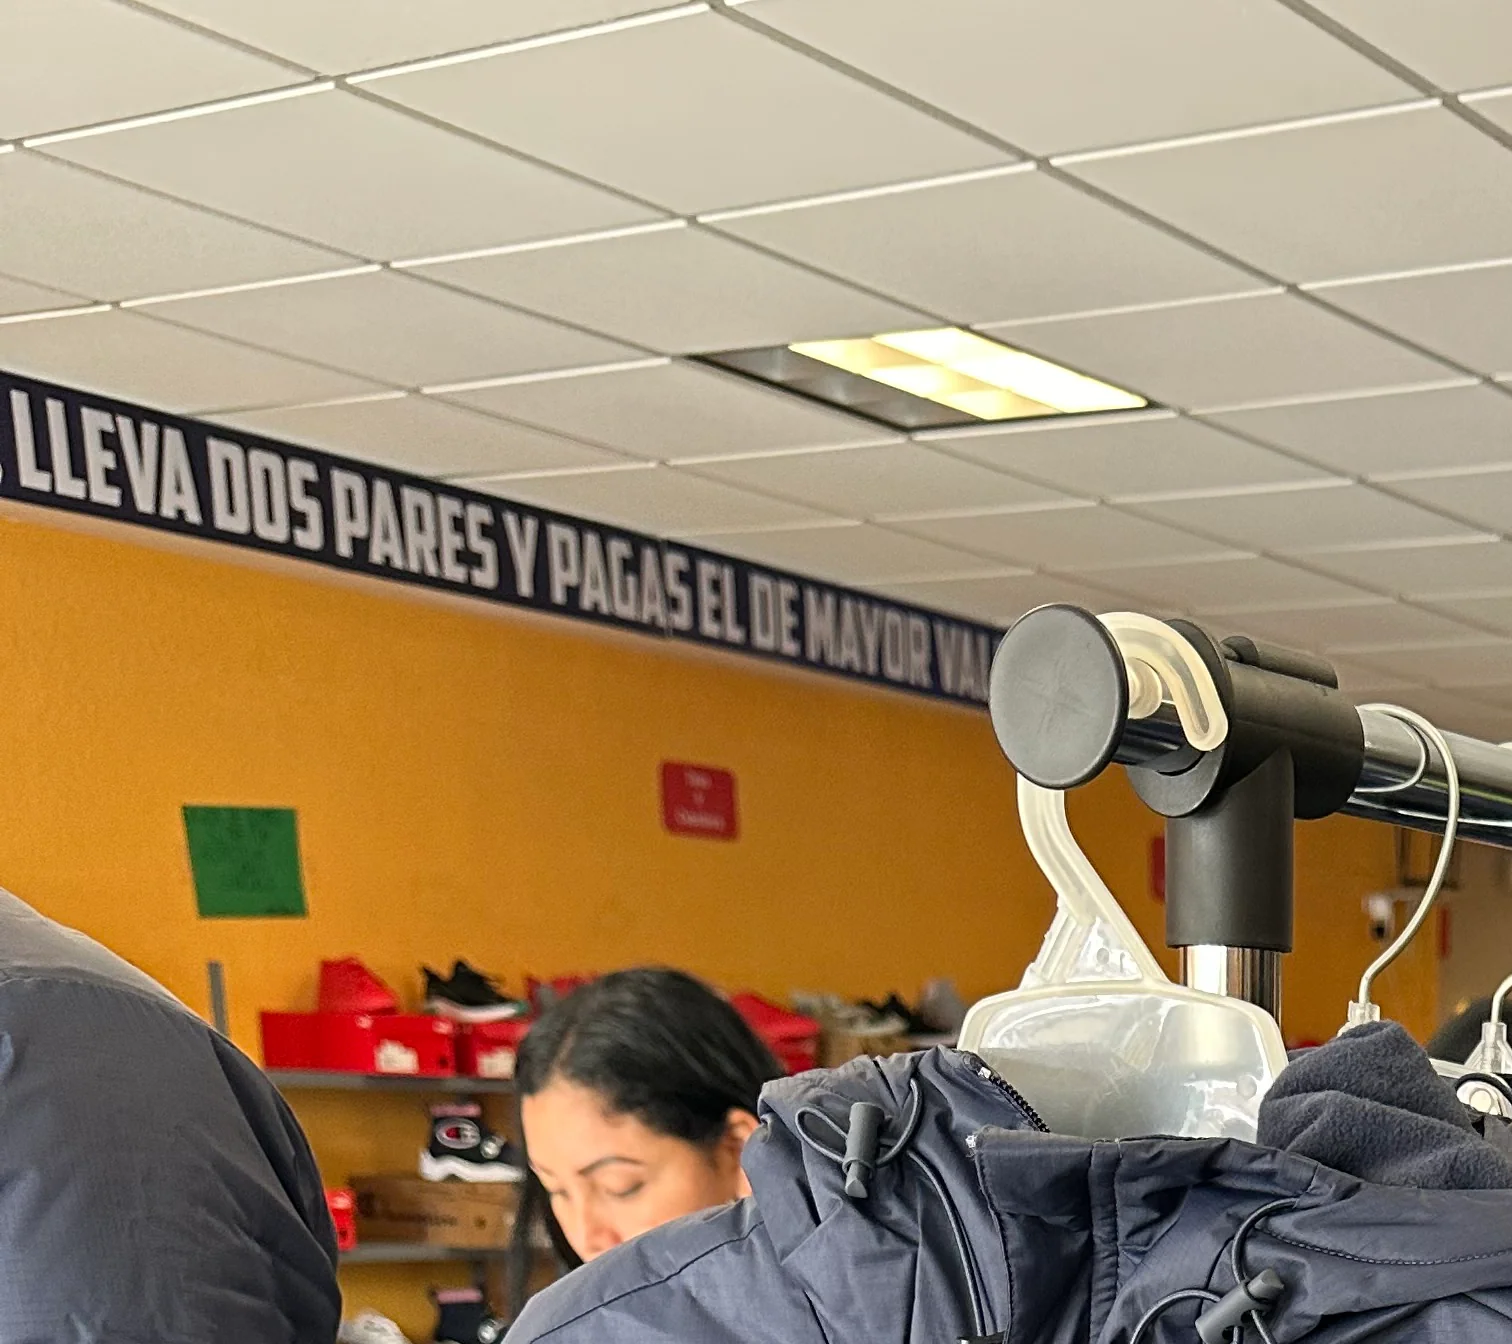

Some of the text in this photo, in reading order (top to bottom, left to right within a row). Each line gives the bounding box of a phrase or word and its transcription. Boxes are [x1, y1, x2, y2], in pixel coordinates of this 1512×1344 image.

[10, 388, 994, 699] LLEVA DOS PARES Y PAGAS EL DE MAYOR VAL
